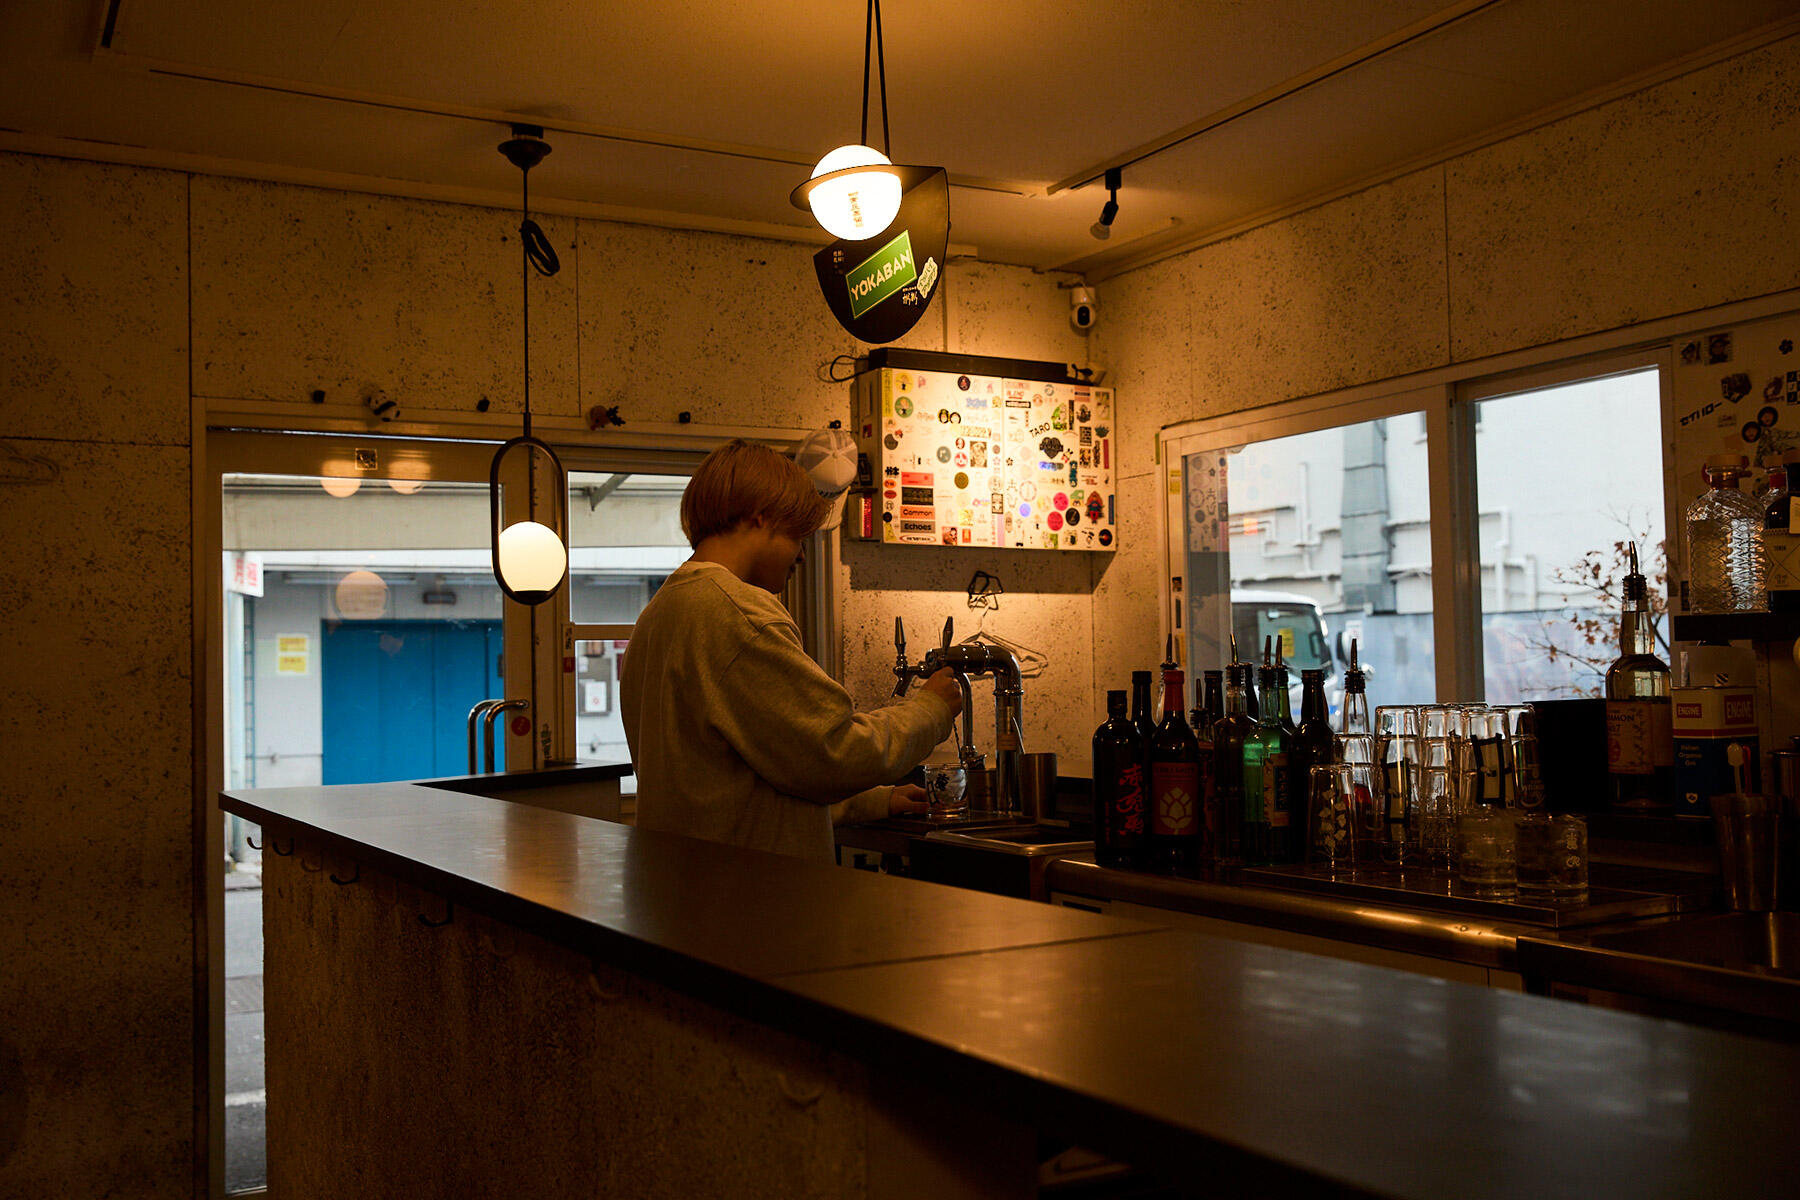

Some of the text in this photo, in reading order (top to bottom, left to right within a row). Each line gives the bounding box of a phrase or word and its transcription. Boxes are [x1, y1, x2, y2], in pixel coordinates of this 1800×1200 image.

[850, 249, 912, 301] YOKABAN
[1029, 421, 1051, 438] TARO
[904, 522, 932, 531] Echoes
[1678, 706, 1701, 716] ENGINE
